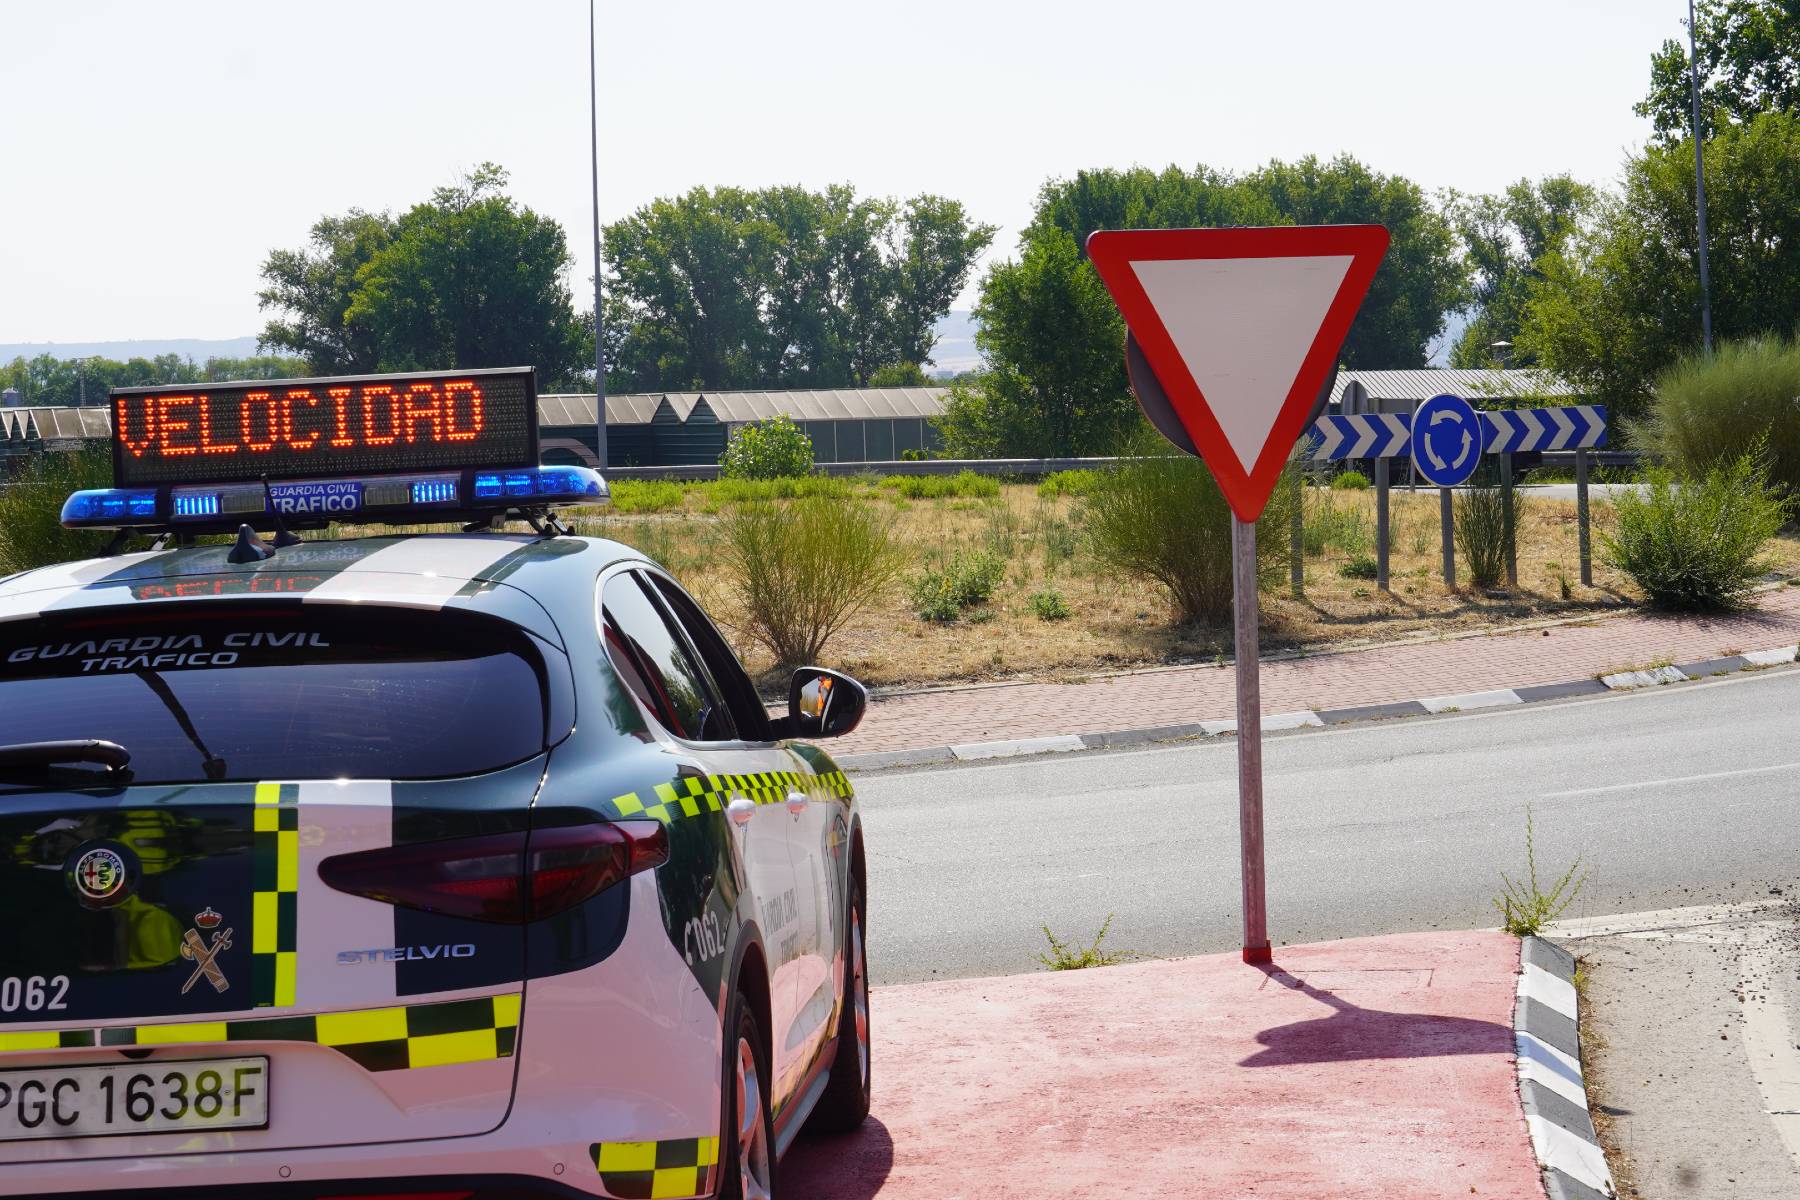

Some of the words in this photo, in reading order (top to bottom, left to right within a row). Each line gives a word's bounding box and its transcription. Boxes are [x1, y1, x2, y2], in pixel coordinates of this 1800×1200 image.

[118, 382, 482, 456] VELOCIDAD
[270, 485, 325, 497] GUARDIA
[327, 483, 358, 494] CIVIL
[7, 634, 203, 663] GUARDIA
[223, 632, 331, 647] CIVIL
[80, 651, 239, 672] TRÁFICO
[691, 911, 726, 962] 062
[336, 943, 476, 965] STELVIO
[1, 974, 70, 1012] 062
